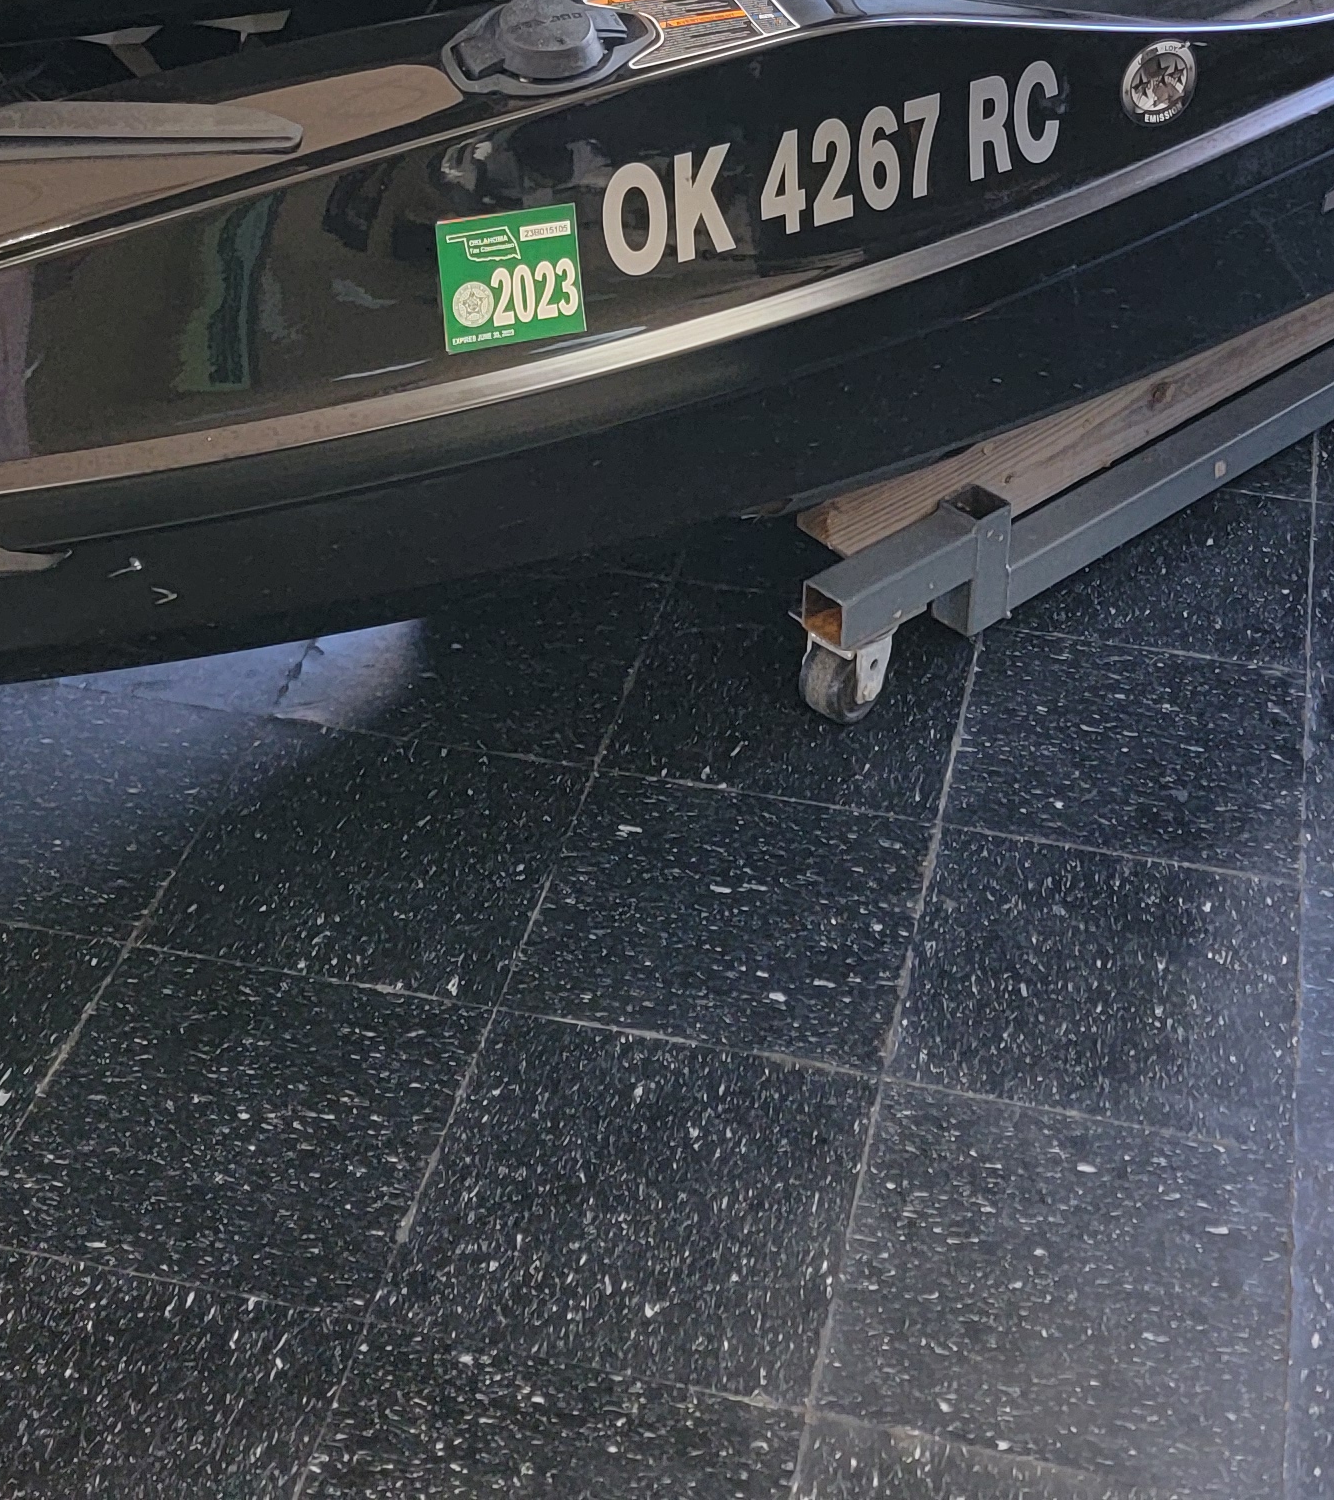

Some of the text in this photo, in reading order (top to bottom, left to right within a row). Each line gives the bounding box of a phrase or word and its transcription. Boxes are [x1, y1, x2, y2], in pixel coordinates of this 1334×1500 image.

[601, 59, 1062, 277] OK 4267 RC
[490, 257, 579, 327] 2023
